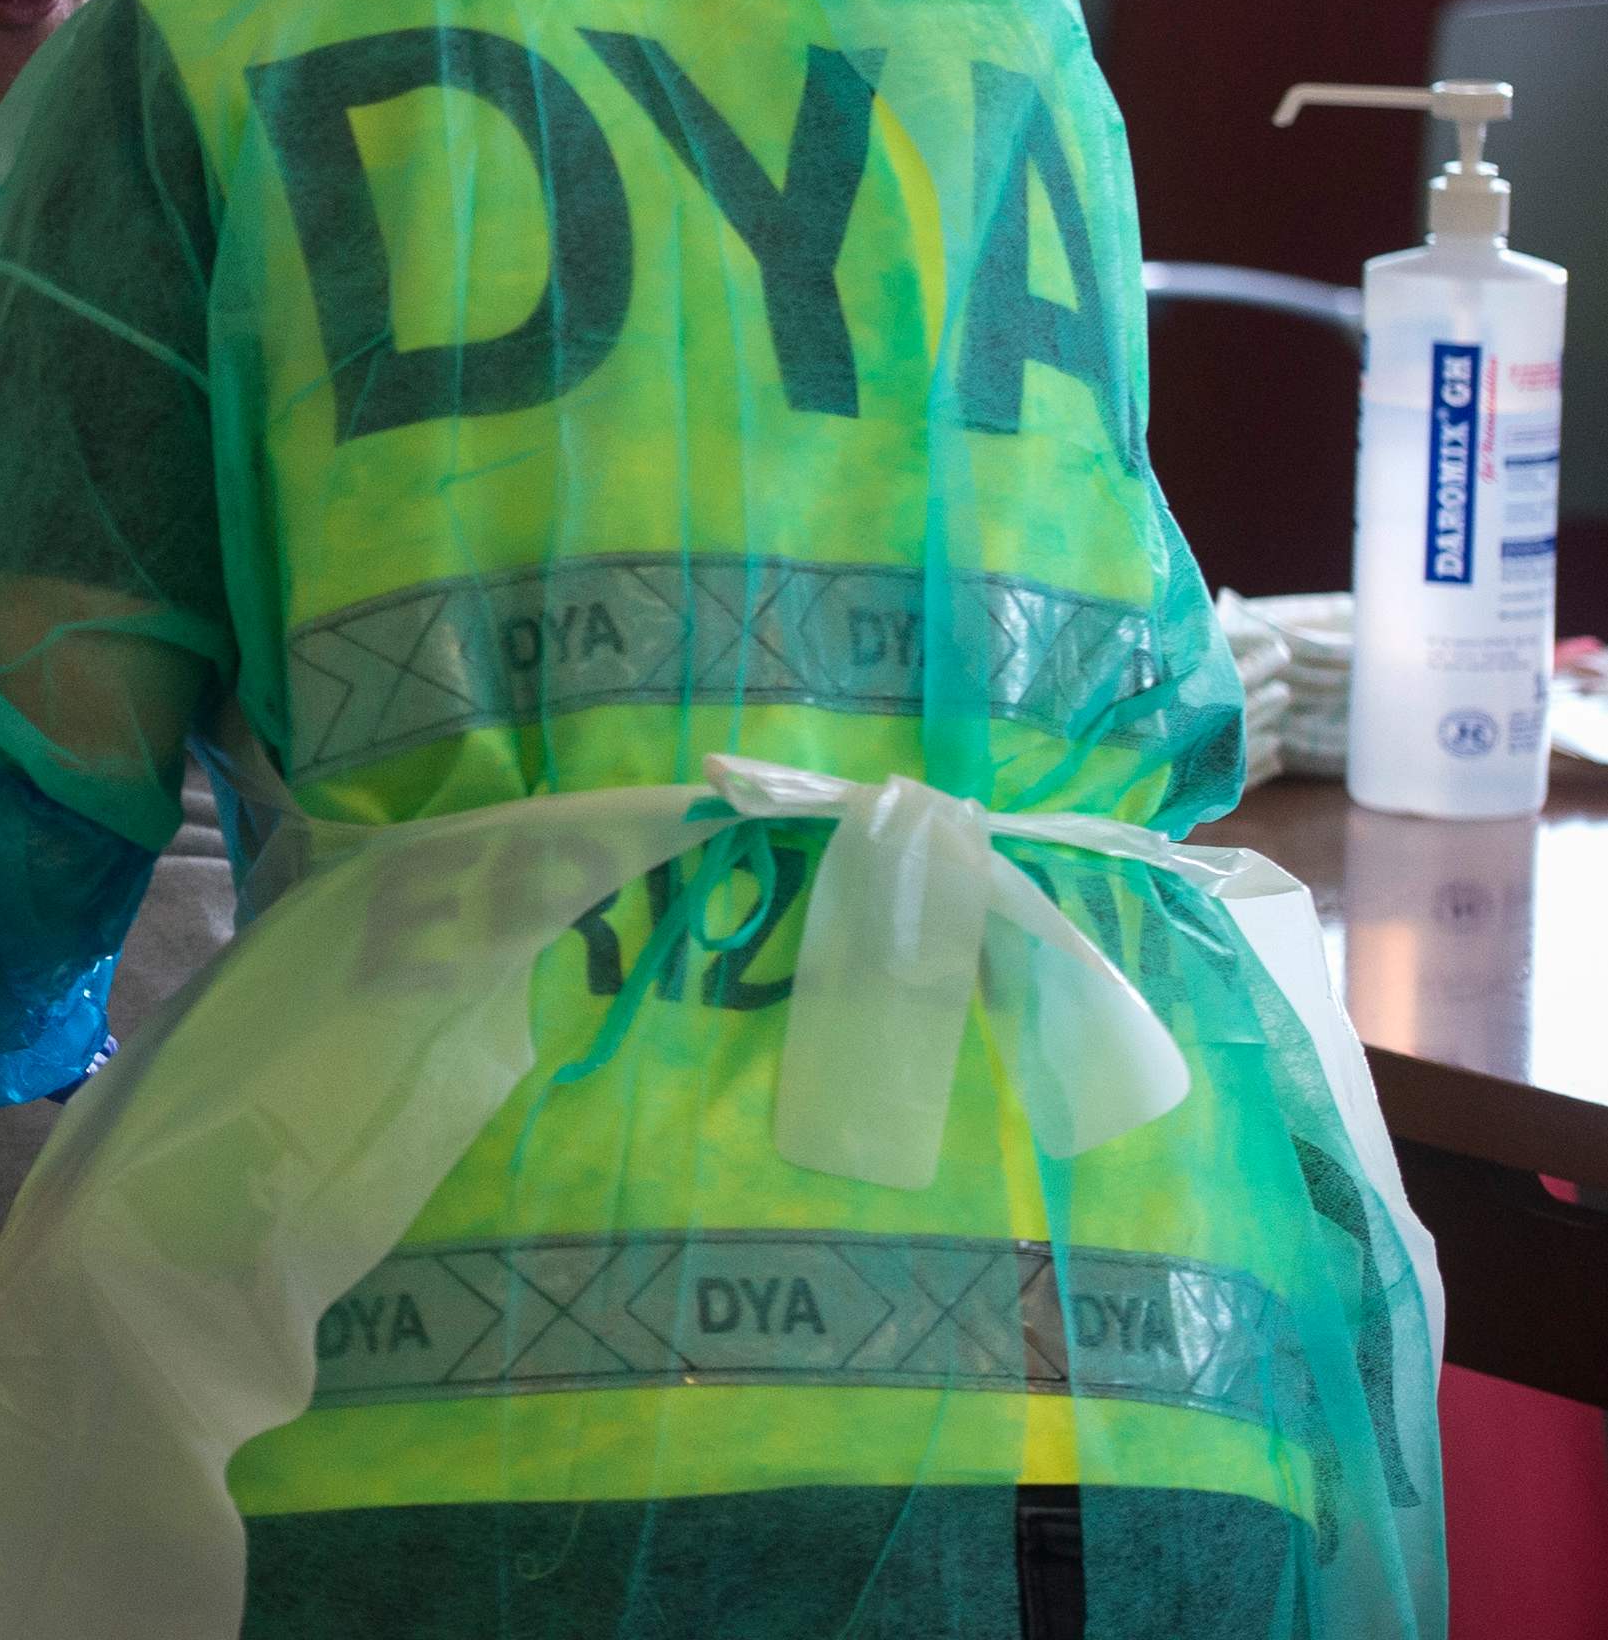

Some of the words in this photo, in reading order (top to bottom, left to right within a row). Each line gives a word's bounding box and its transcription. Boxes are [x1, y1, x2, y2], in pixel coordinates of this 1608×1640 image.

[244, 25, 1148, 477] DYA
[501, 601, 626, 671] DYA
[848, 606, 926, 669] DY
[317, 1291, 432, 1360] DYA
[694, 1276, 826, 1336] DYA
[1070, 1293, 1178, 1356] DYA
